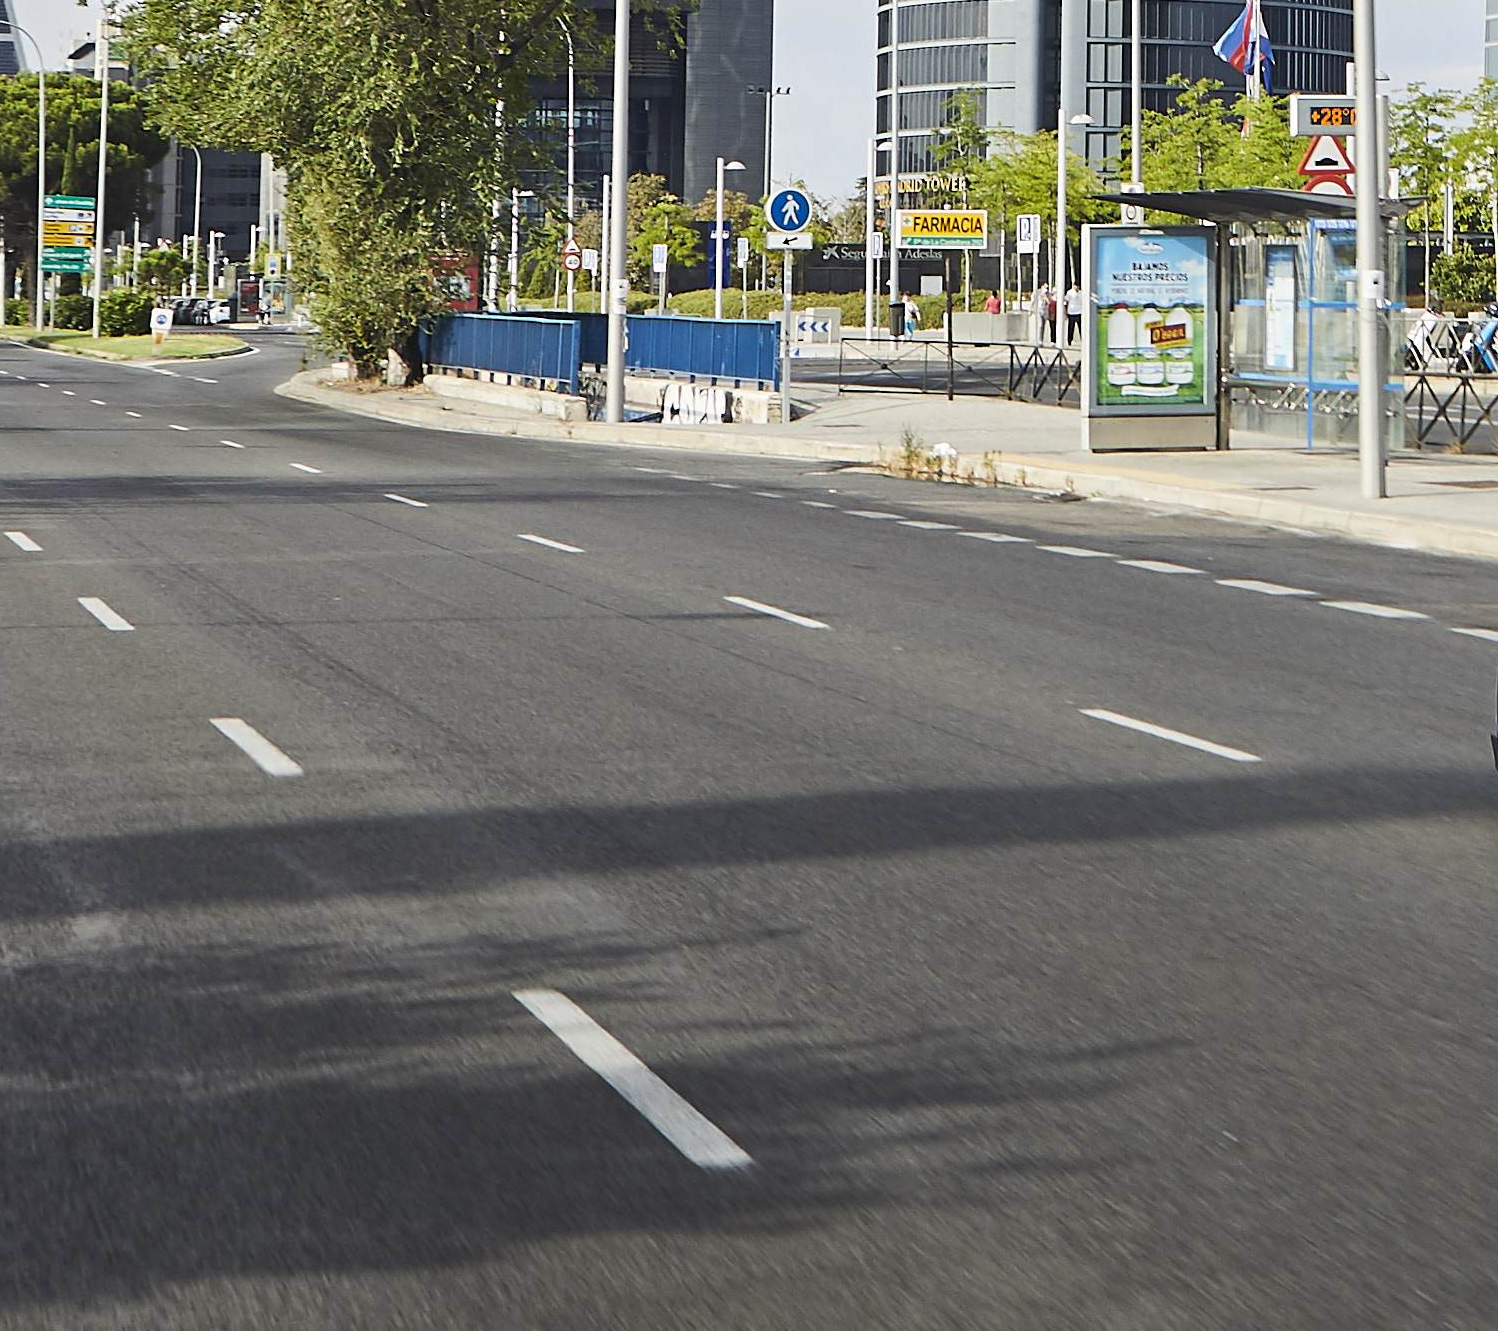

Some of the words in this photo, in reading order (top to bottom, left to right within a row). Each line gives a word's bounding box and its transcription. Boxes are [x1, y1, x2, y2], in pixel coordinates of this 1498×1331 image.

[913, 216, 983, 233] FARMACIA
[904, 249, 943, 259] Adeslas
[1132, 262, 1169, 271] BAJAMOS
[1111, 273, 1153, 282] NUESTROS
[1155, 273, 1189, 282] PRECIOS
